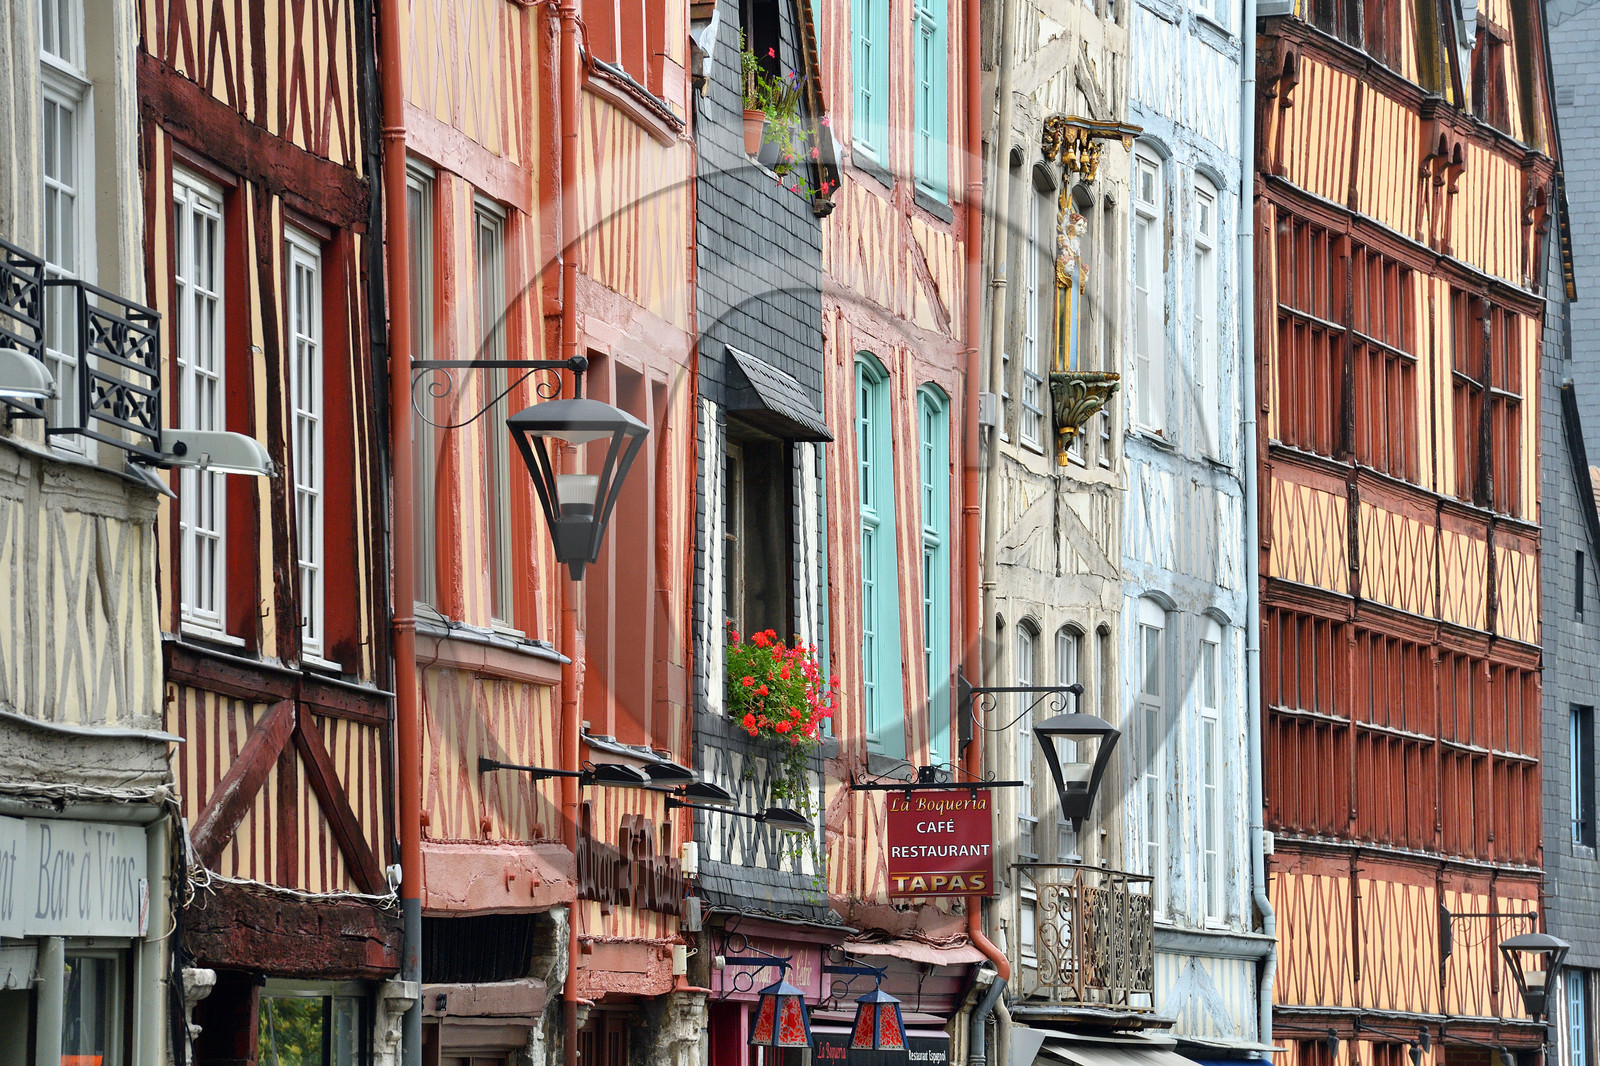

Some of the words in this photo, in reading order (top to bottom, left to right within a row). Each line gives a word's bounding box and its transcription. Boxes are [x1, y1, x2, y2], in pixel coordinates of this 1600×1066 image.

[890, 797, 910, 812] La
[916, 797, 988, 816] Boqueria
[916, 818, 956, 834] CAFÉ
[891, 844, 990, 858] RESTAURANT
[35, 823, 75, 921] Bar
[97, 830, 136, 923] Vins
[891, 874, 987, 892] TAPAS
[817, 1041, 825, 1059] La
[908, 1049, 929, 1061] Restaurant
[928, 1049, 947, 1065] Espagnol
